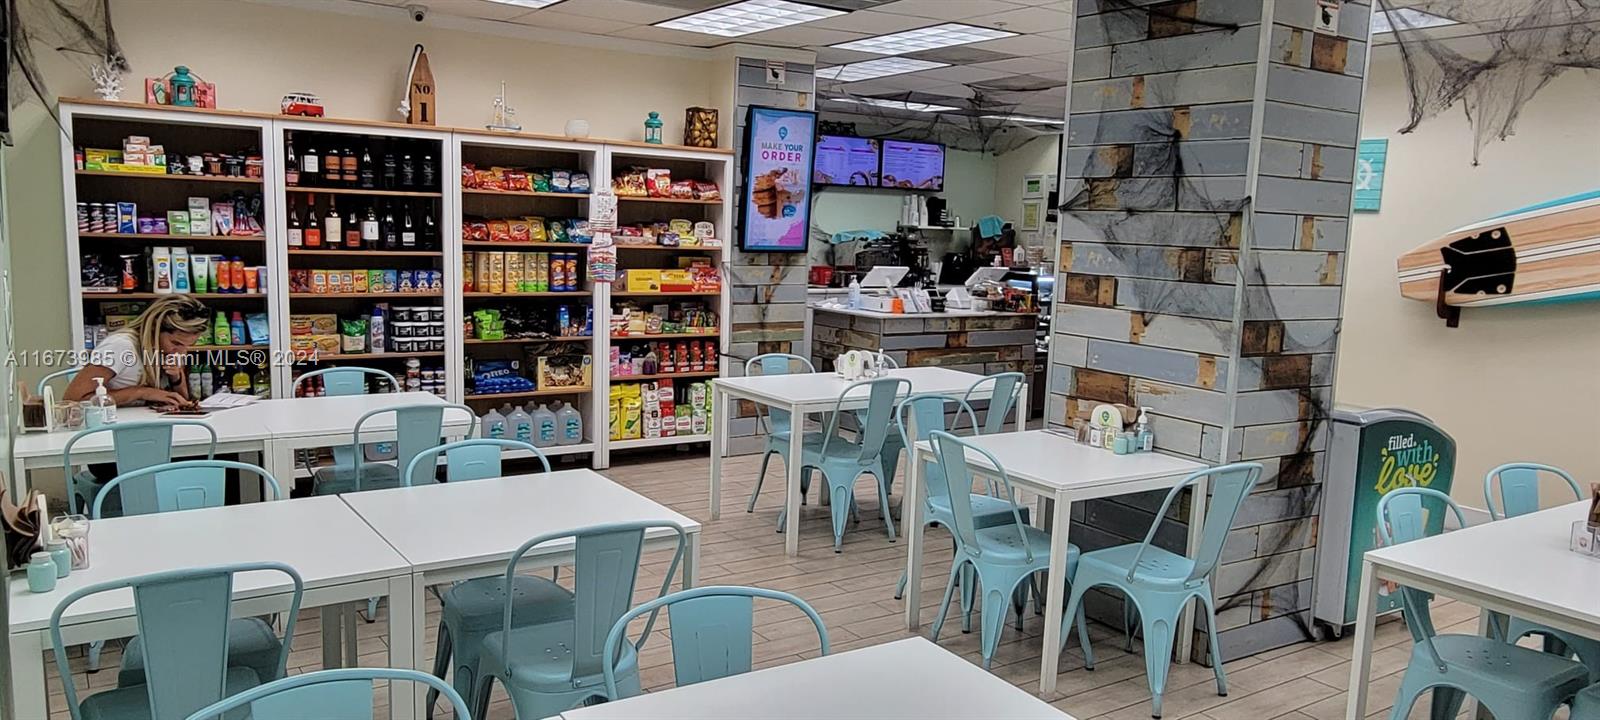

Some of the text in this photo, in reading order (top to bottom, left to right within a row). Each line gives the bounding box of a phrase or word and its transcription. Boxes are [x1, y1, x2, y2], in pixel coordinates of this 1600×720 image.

[413, 83, 433, 95] NO.
[761, 142, 803, 152] MAKE YOUR
[761, 150, 801, 162] ORDER
[1397, 440, 1433, 467] with
[1374, 456, 1437, 494] love
